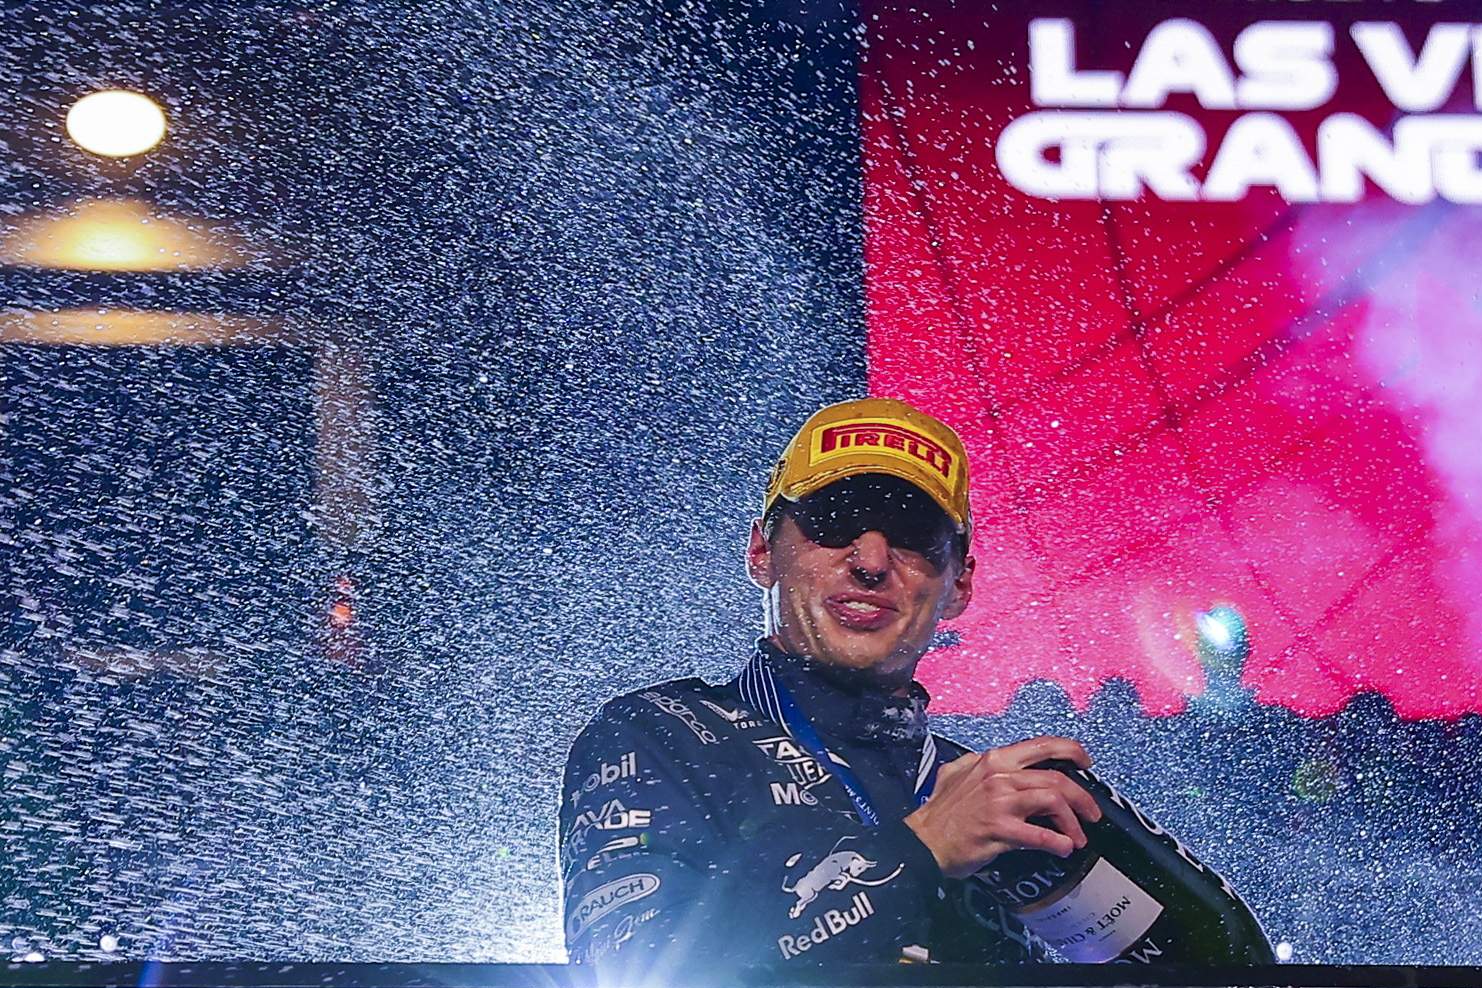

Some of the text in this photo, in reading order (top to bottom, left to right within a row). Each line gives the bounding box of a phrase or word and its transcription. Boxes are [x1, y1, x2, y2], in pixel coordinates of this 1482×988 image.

[1029, 17, 1337, 110] LAS
[821, 422, 953, 478] PIRELLI
[638, 691, 718, 745] sparco
[579, 878, 645, 922] RAUCH
[778, 891, 875, 961] Red Bull
